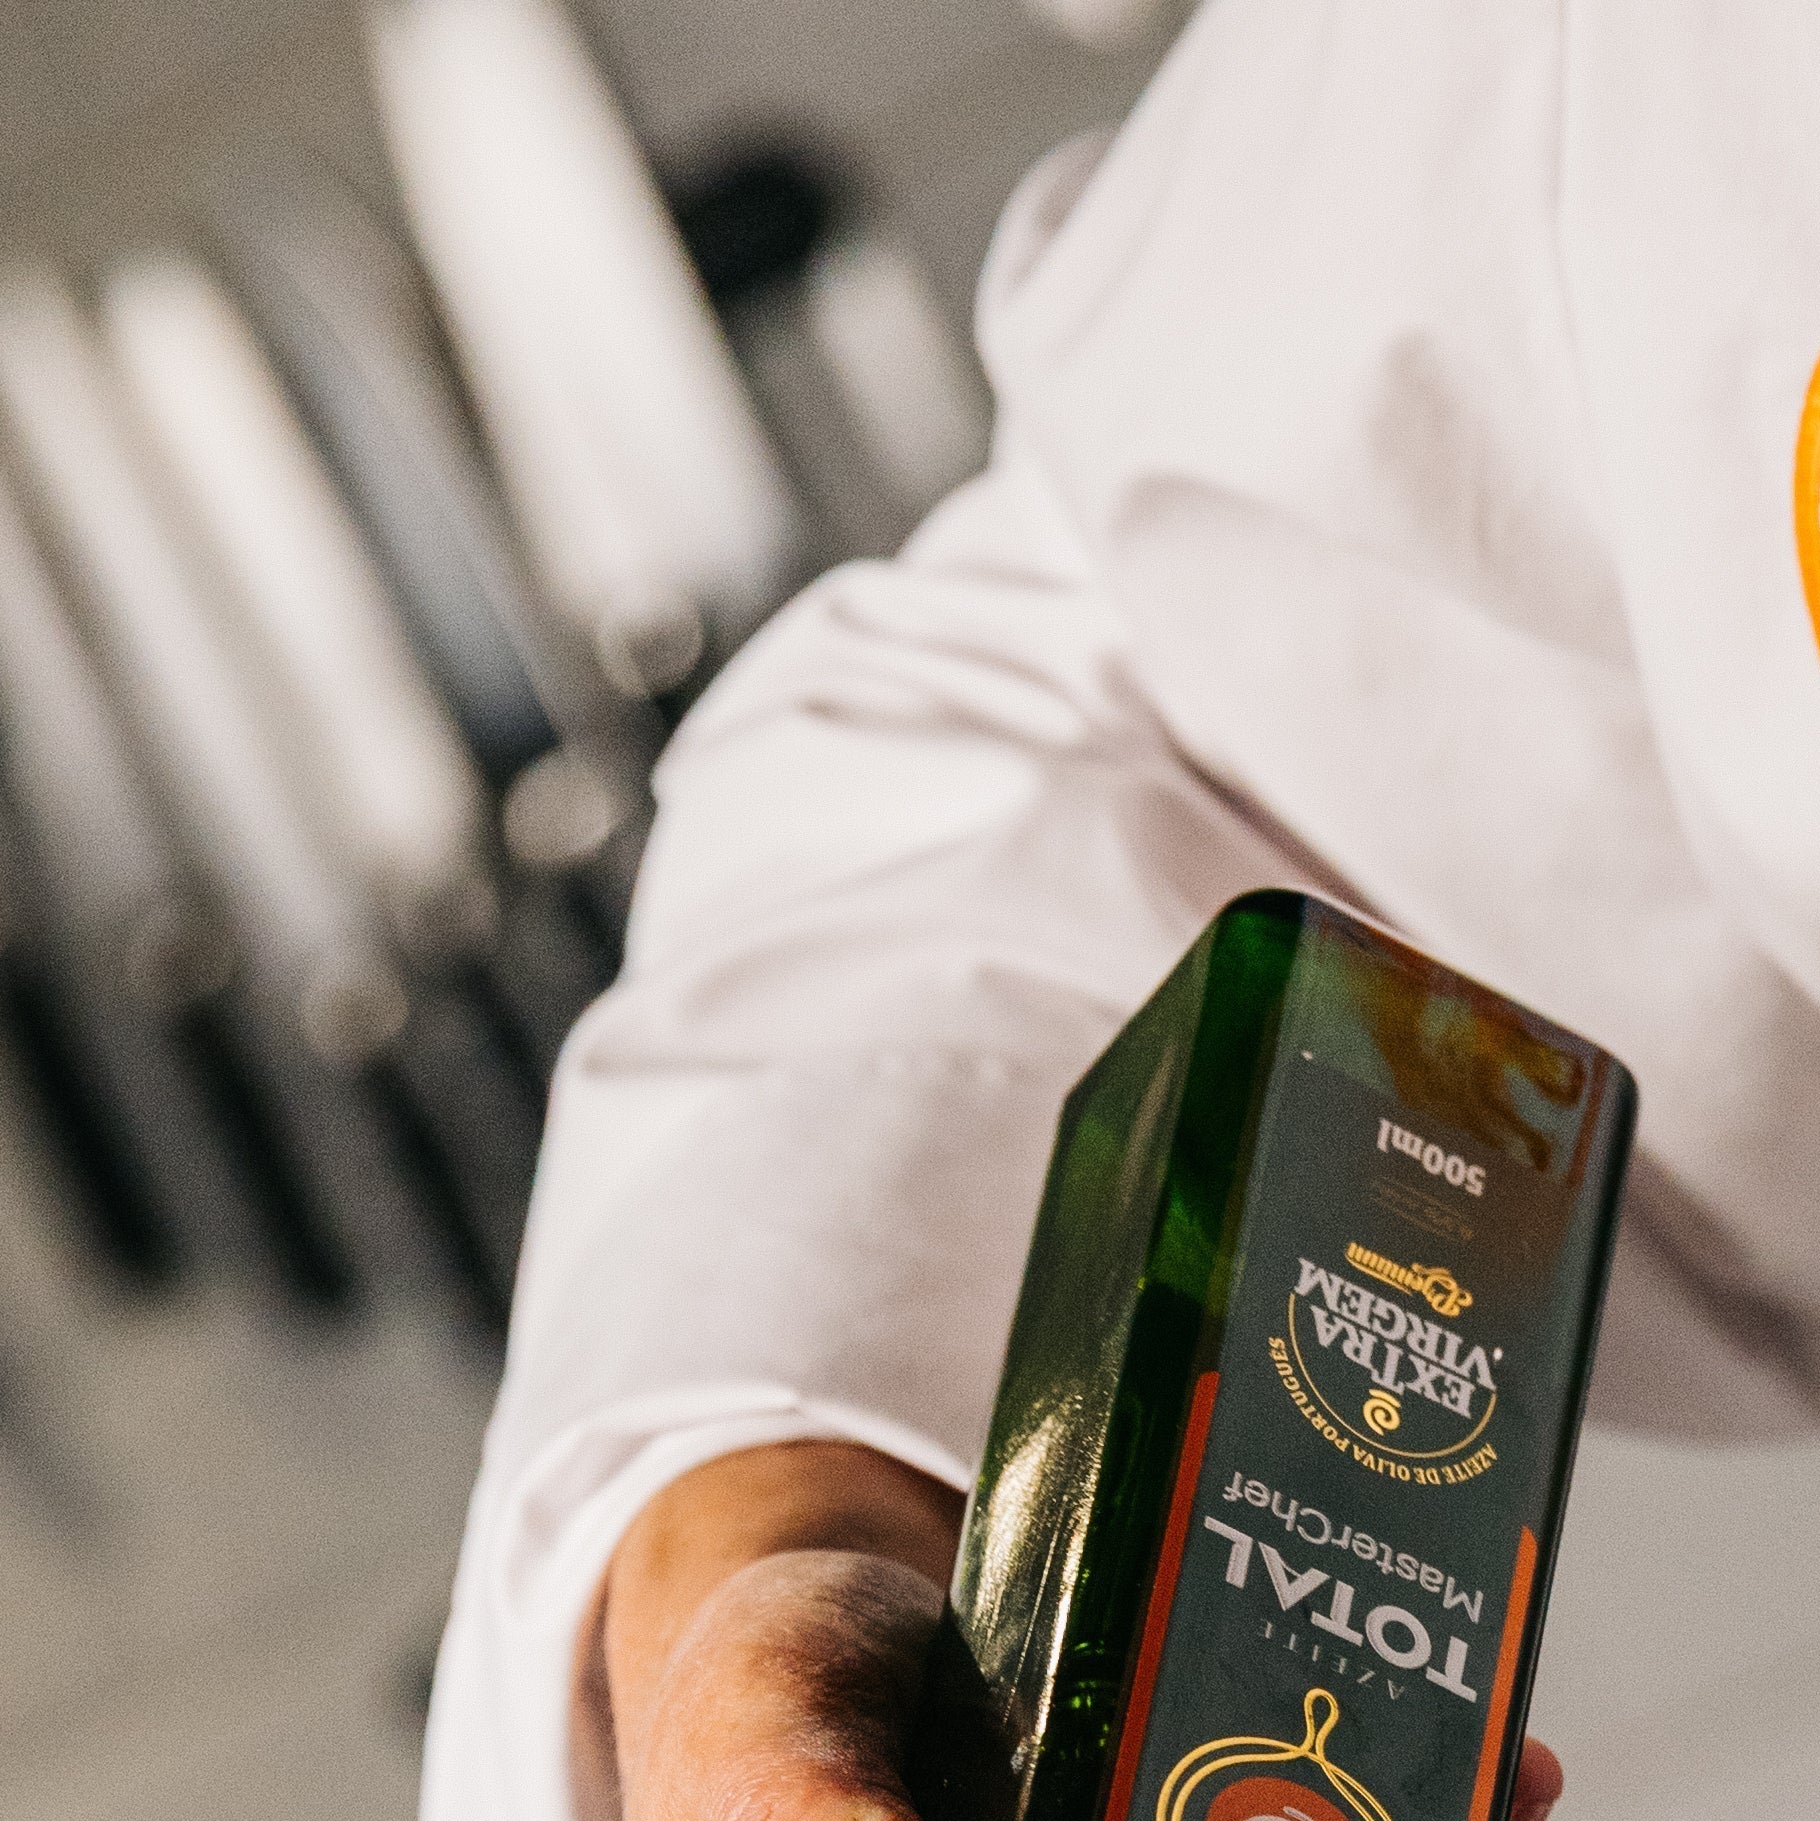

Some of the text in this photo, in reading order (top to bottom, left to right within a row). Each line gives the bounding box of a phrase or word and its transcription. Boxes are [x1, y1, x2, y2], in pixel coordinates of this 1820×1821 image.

[1376, 1117, 1487, 1197] 500ml
[1344, 1241, 1474, 1318] Premium
[1294, 1257, 1497, 1391] VIRGEM
[1310, 1305, 1475, 1419] EXTRA
[1353, 1443, 1410, 1483] OLIVA
[1414, 1466, 1441, 1486] DE
[1446, 1442, 1498, 1485] AZEITE
[1222, 1471, 1484, 1624] MasterChef
[1203, 1515, 1477, 1703] TOTAL
[1260, 1618, 1406, 1700] AZEITE
